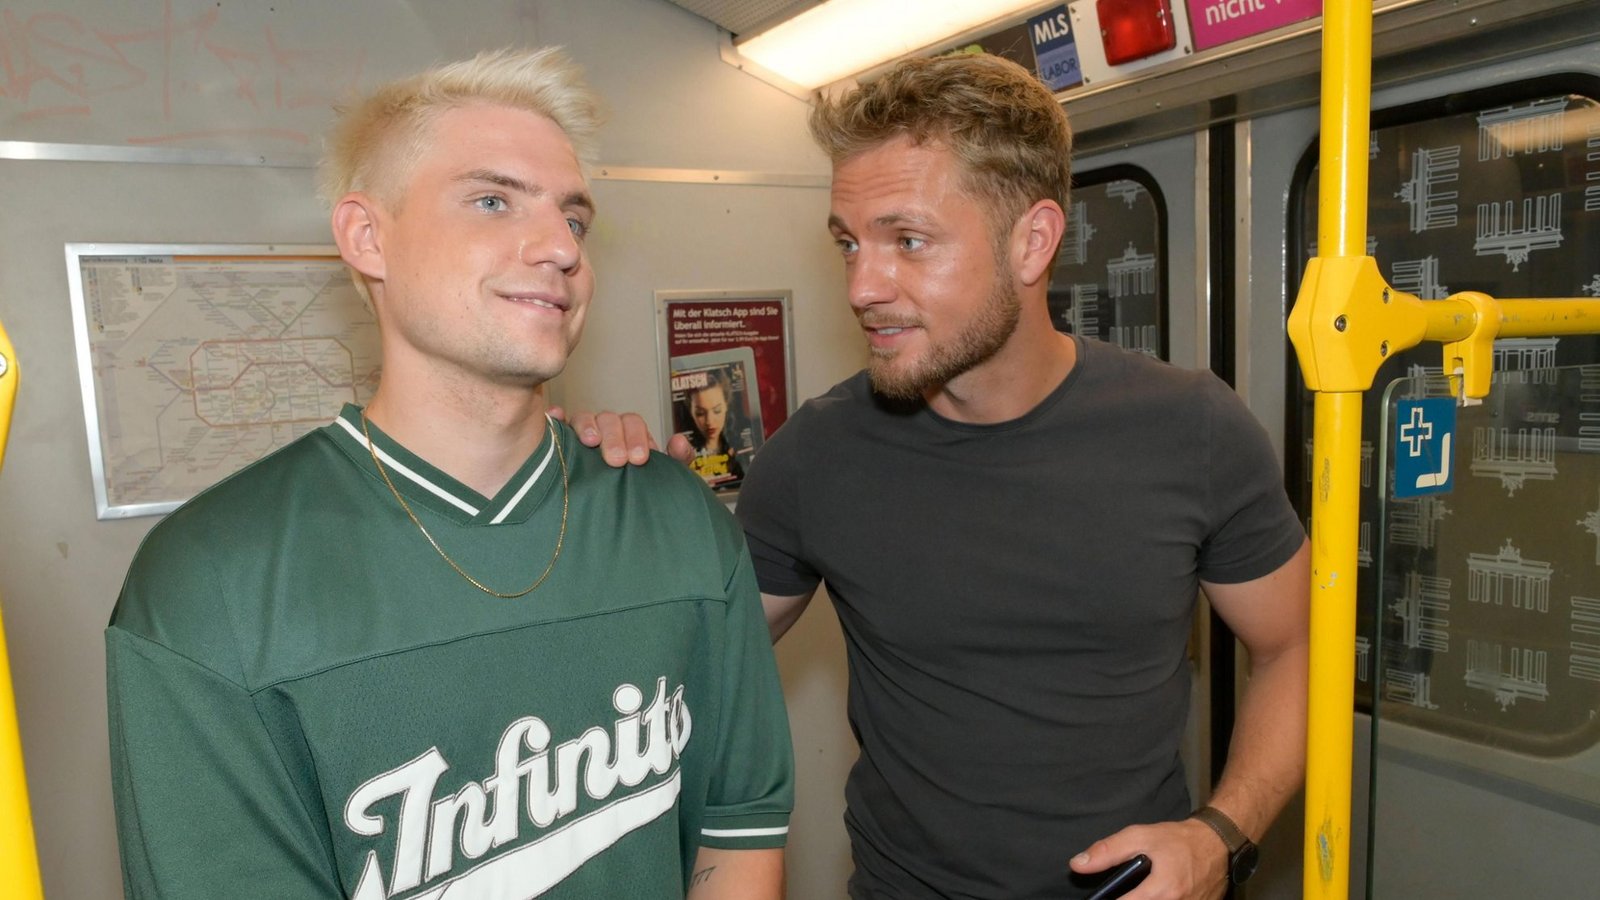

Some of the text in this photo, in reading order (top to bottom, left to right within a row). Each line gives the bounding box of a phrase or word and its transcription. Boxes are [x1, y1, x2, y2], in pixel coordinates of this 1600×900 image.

[1034, 17, 1069, 46] MLS
[1042, 57, 1078, 80] LABOR
[673, 306, 779, 319] Mit der Klatsch App sind Sie
